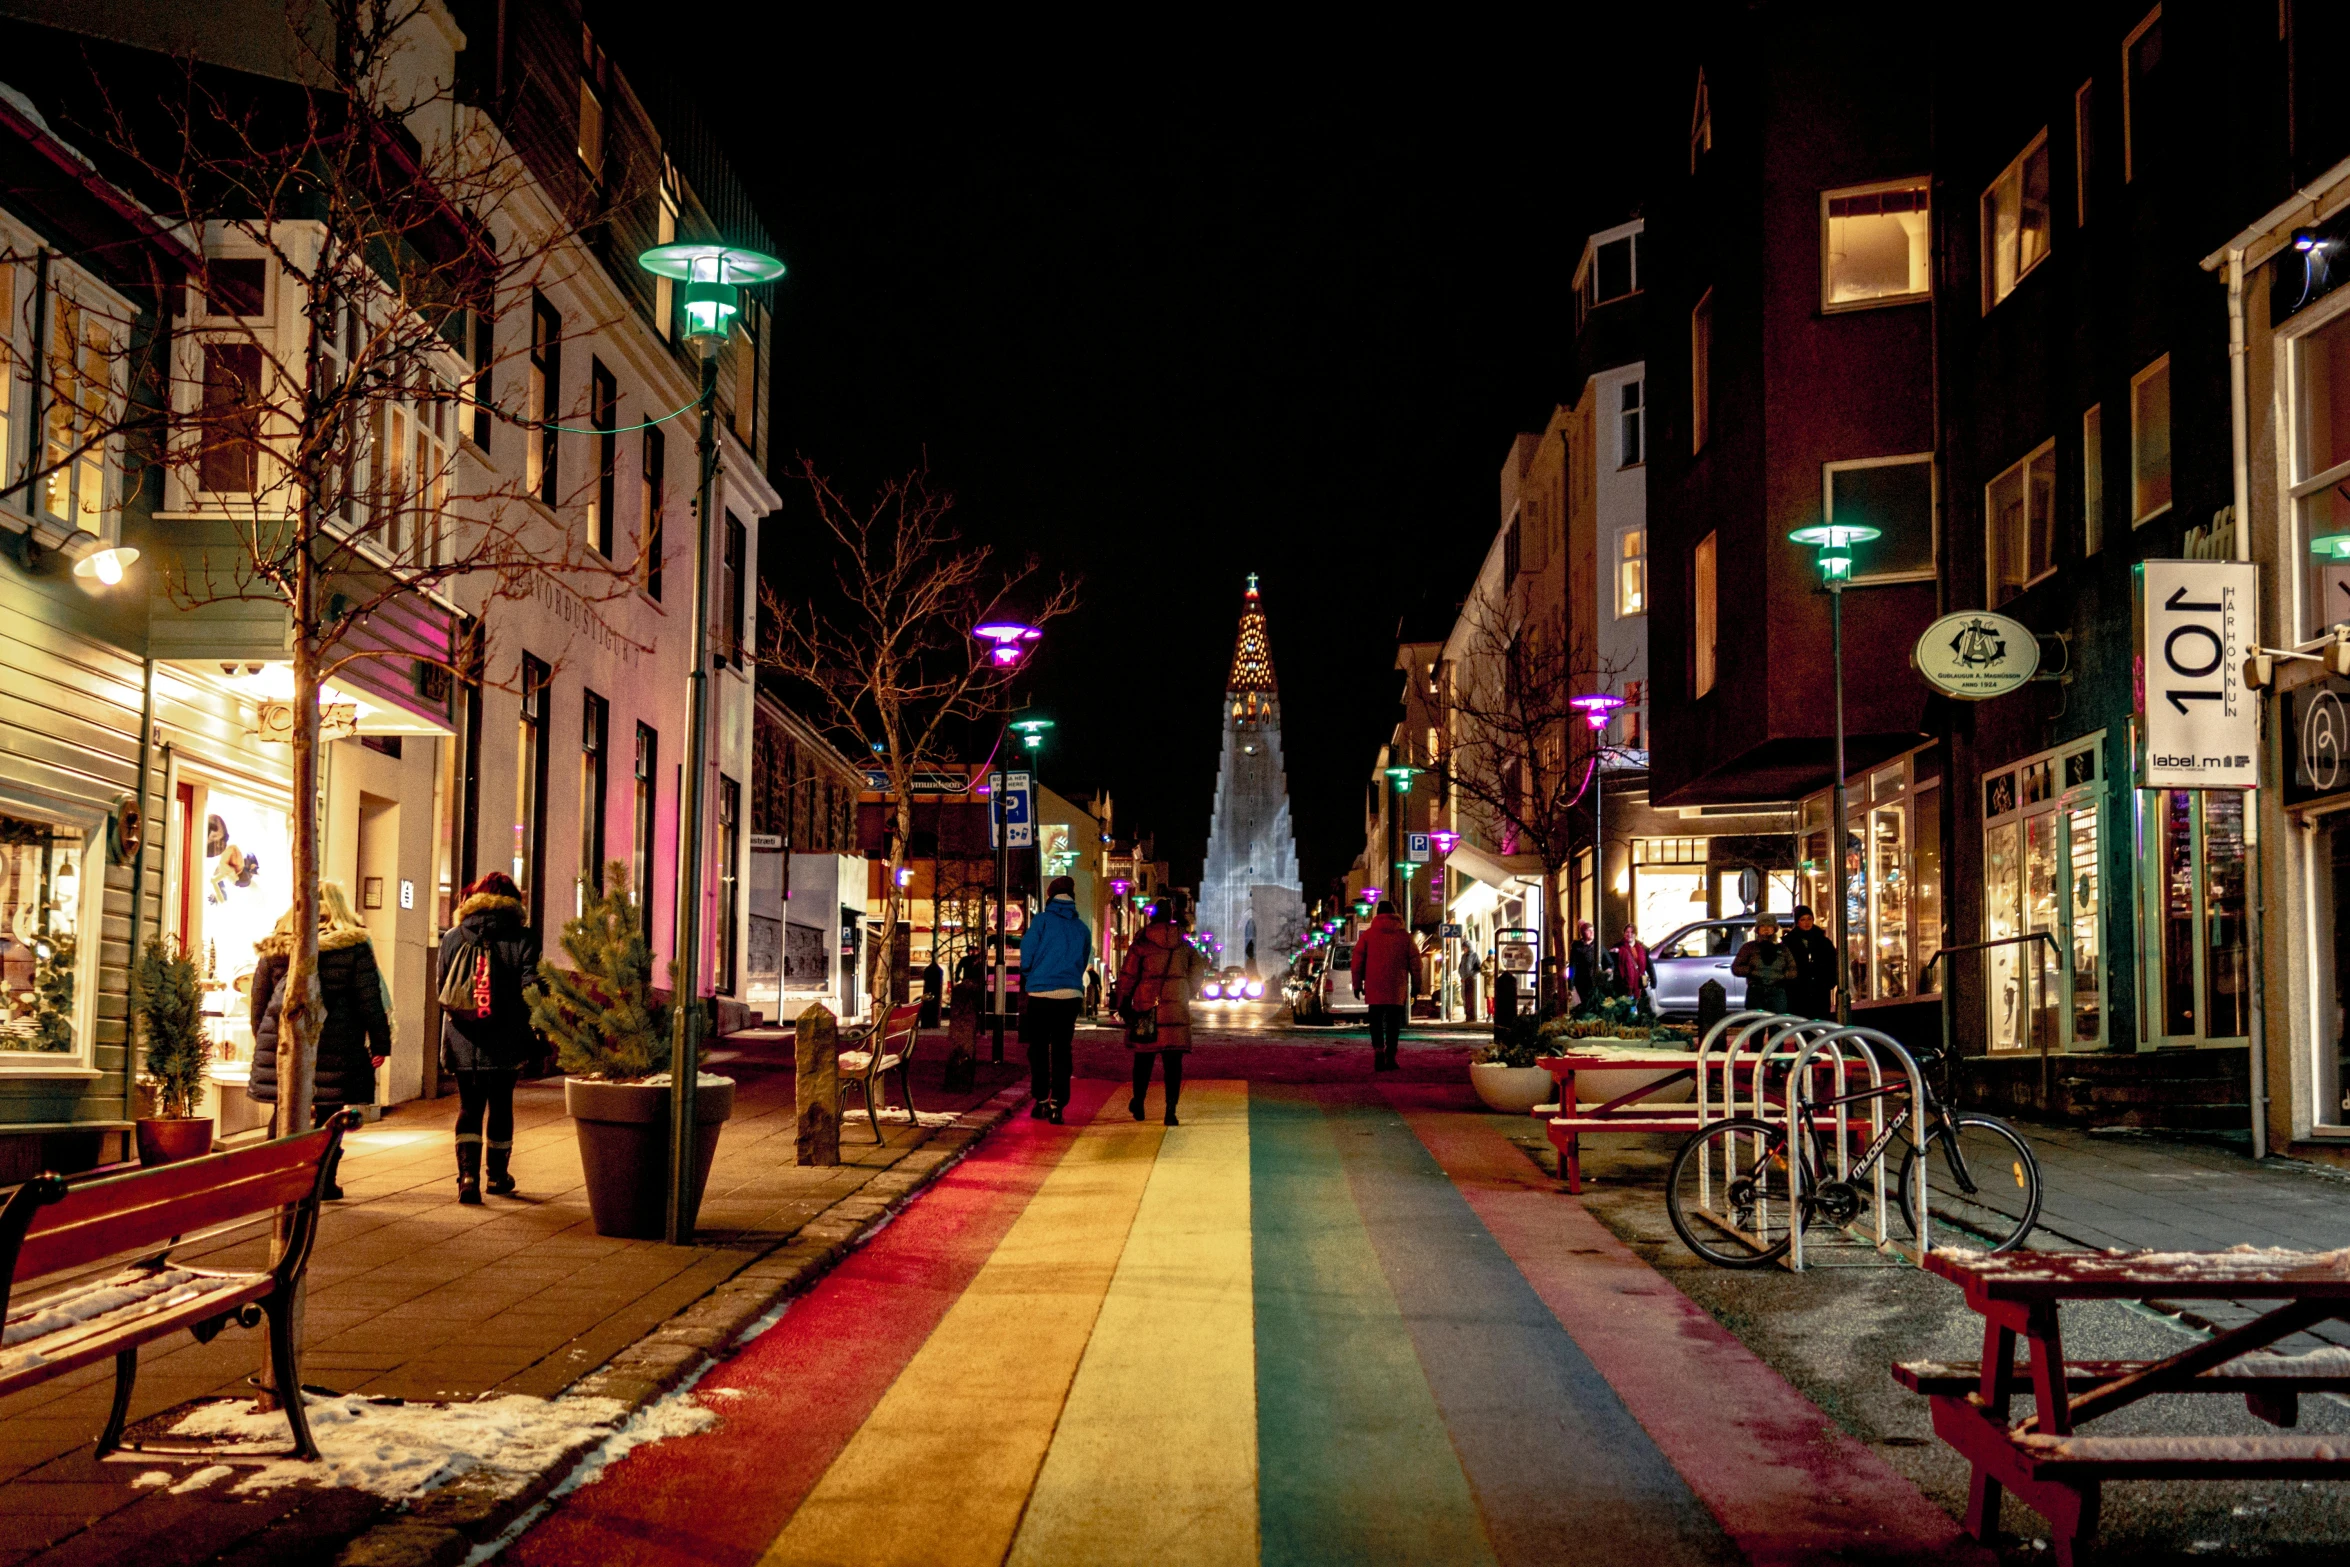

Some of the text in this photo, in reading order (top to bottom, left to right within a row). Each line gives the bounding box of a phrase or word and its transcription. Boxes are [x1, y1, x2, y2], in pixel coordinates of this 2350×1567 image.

[2164, 586, 2224, 716] 101
[2226, 586, 2238, 717] HÁRHÖNNUN
[2153, 754, 2221, 768] label.m
[1414, 837, 1424, 850] P
[1441, 926, 1450, 937] P
